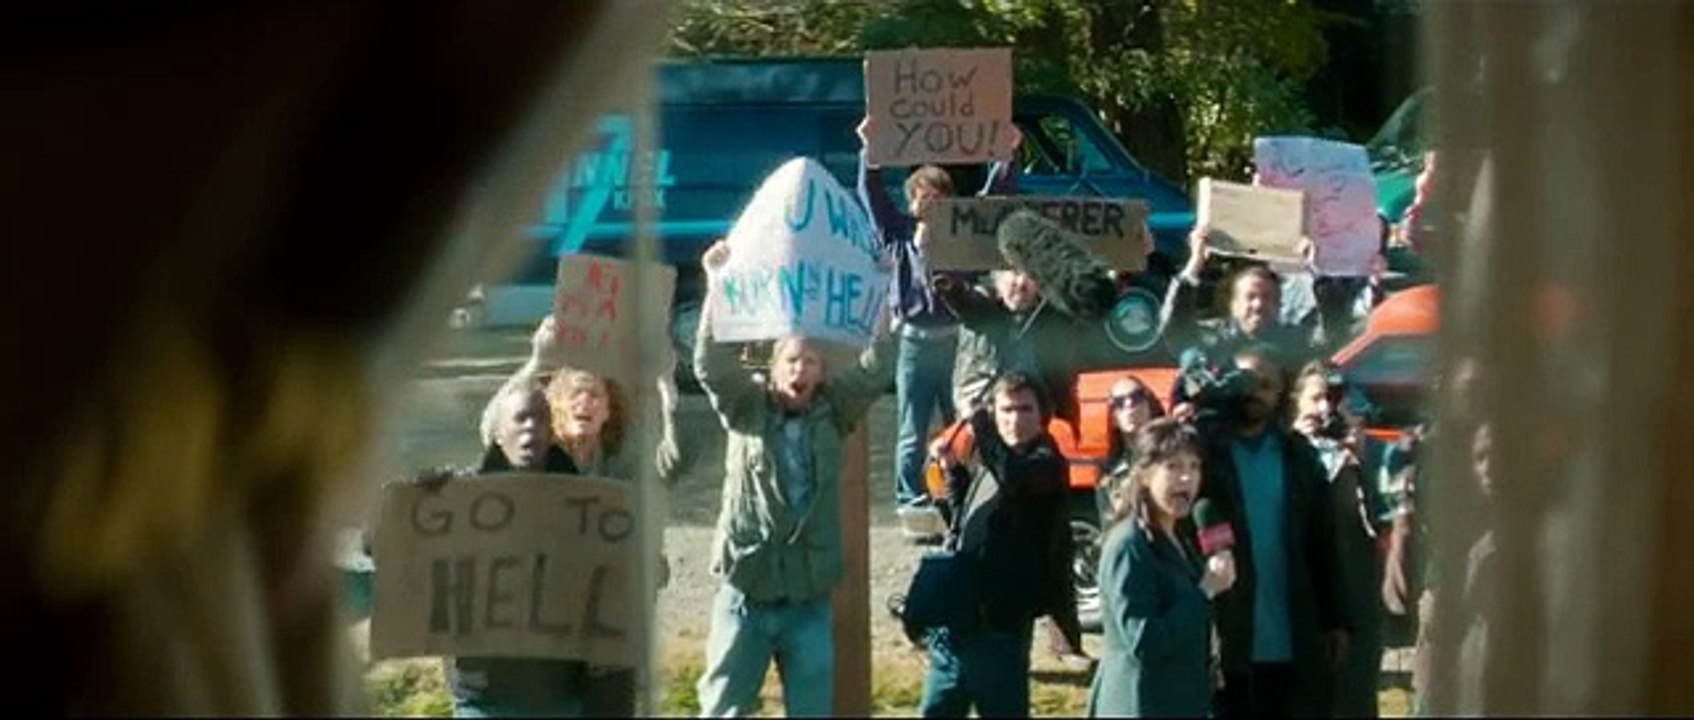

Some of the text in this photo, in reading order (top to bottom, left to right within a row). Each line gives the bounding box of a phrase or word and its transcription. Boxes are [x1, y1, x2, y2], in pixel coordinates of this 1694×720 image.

[897, 120, 1001, 157] YOU!
[950, 201, 1126, 240] MUERER
[410, 492, 635, 543] GO TO
[426, 553, 628, 639] HELL
